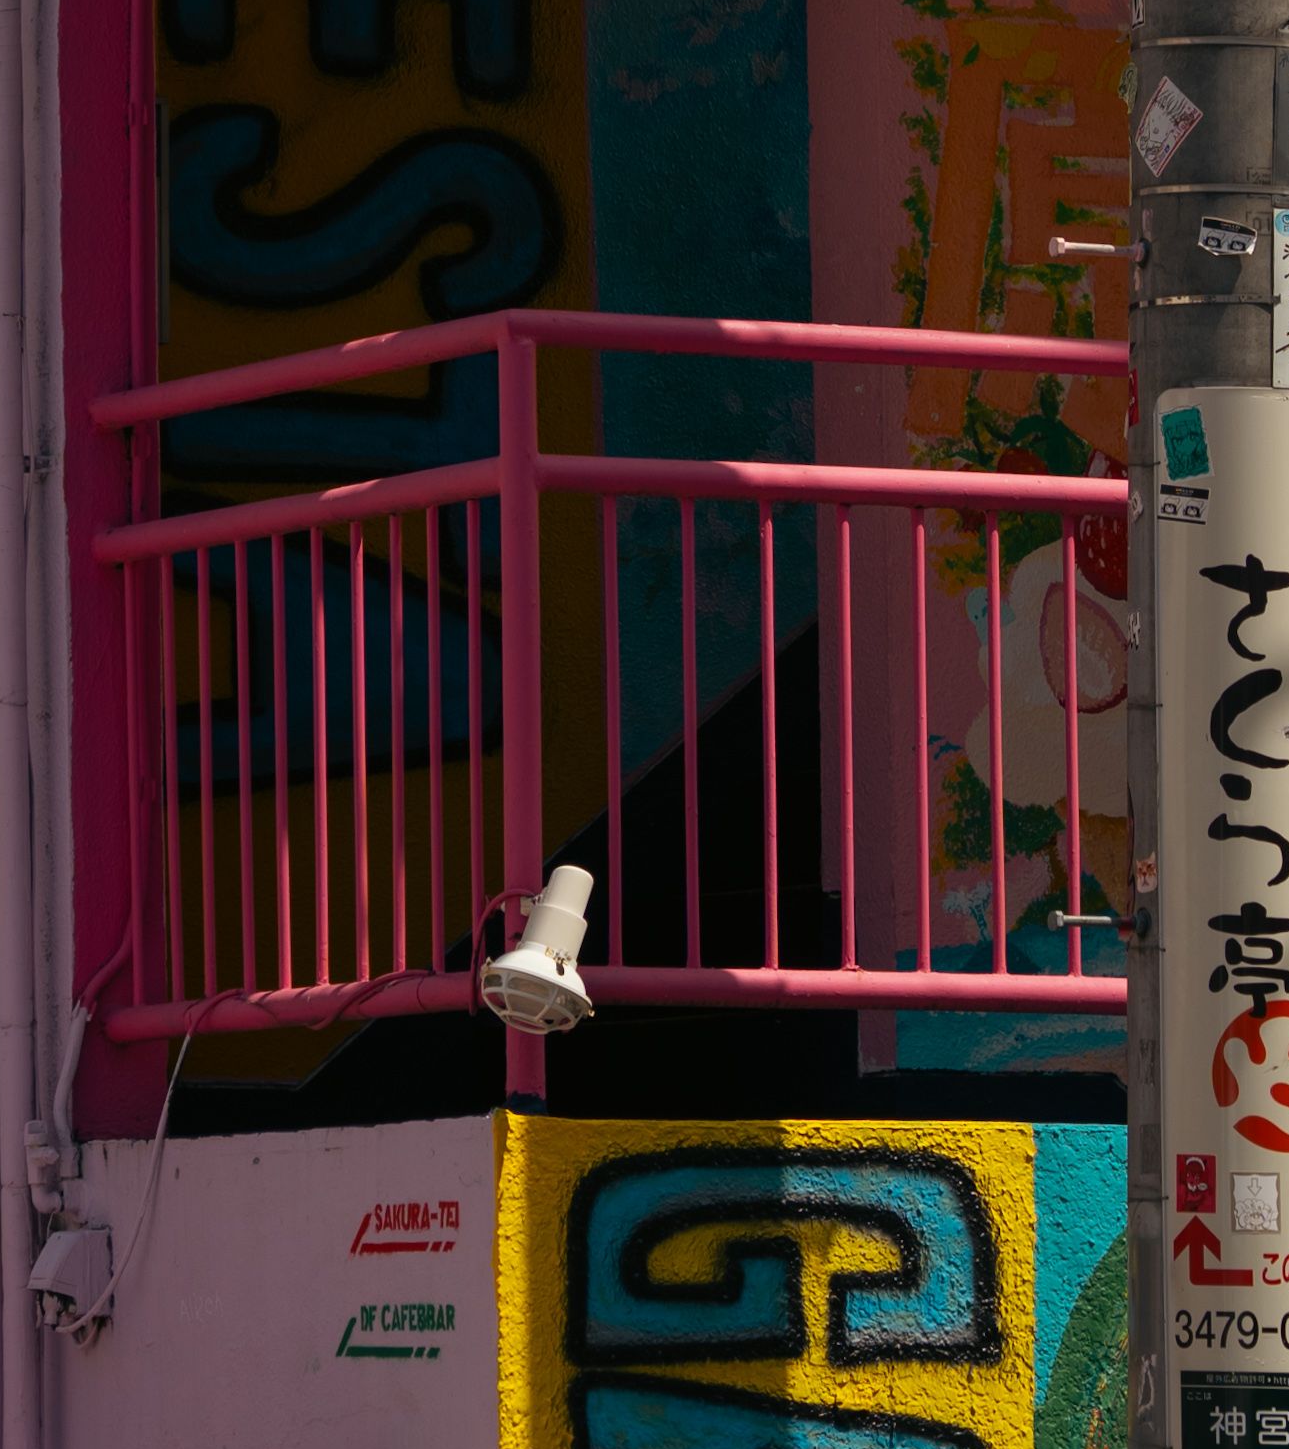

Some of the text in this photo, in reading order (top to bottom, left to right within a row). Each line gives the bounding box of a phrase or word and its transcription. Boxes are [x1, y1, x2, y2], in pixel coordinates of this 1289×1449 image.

[373, 1201, 460, 1233] SAKURA-TEI
[1186, 1391, 1213, 1402] ここは
